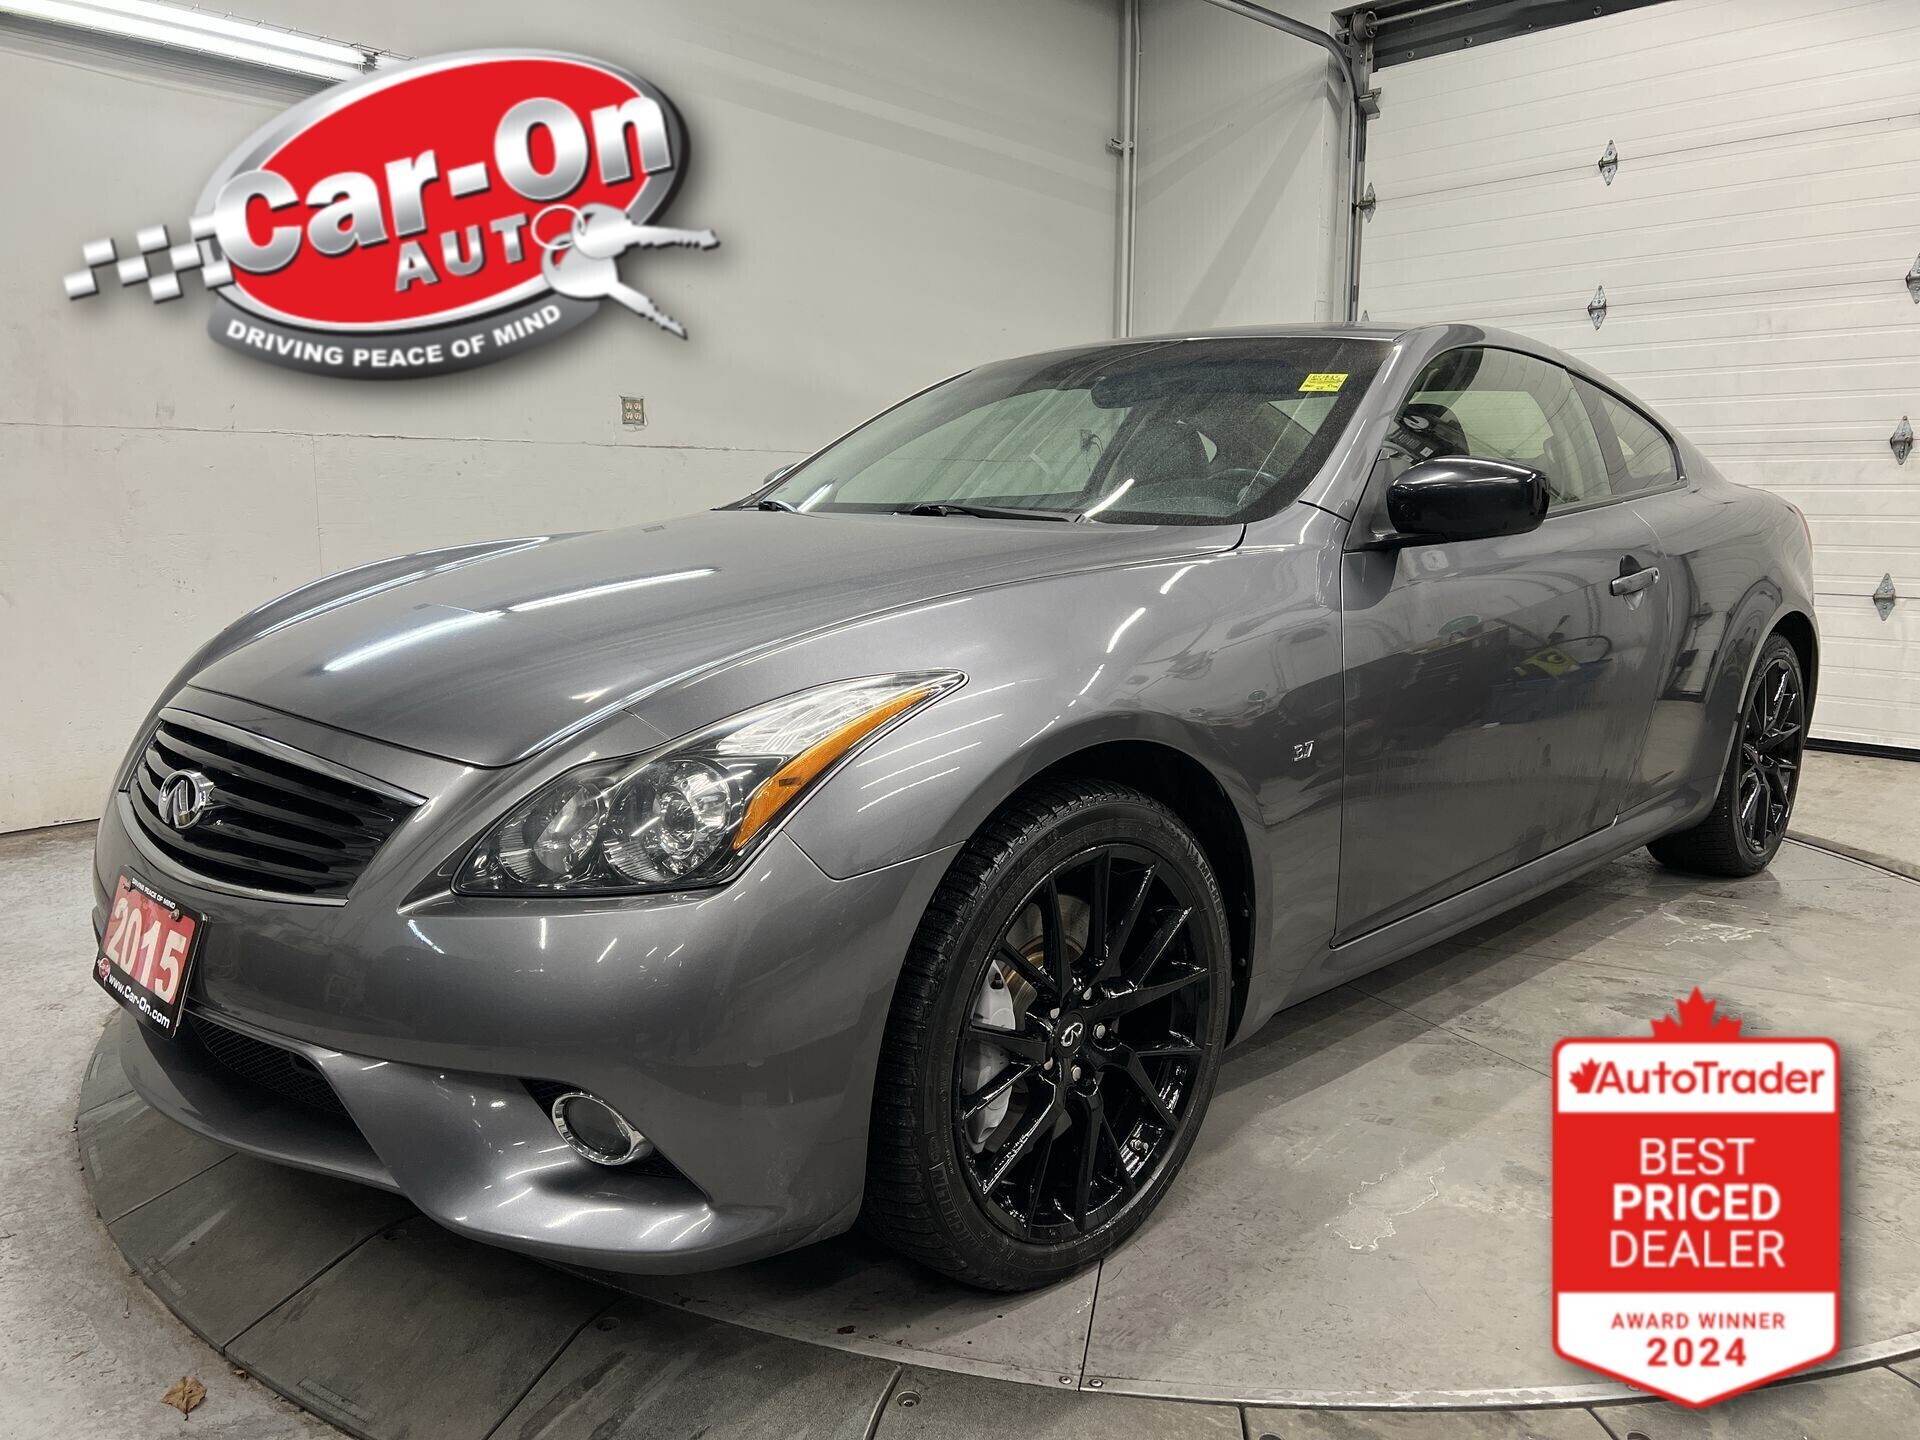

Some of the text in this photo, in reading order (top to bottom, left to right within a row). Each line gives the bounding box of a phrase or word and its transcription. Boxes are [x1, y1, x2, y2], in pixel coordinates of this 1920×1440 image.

[156, 894, 164, 902] OF
[162, 898, 176, 909] MIND
[106, 897, 187, 1003] 2015
[108, 974, 171, 1029] www.Car-On.com
